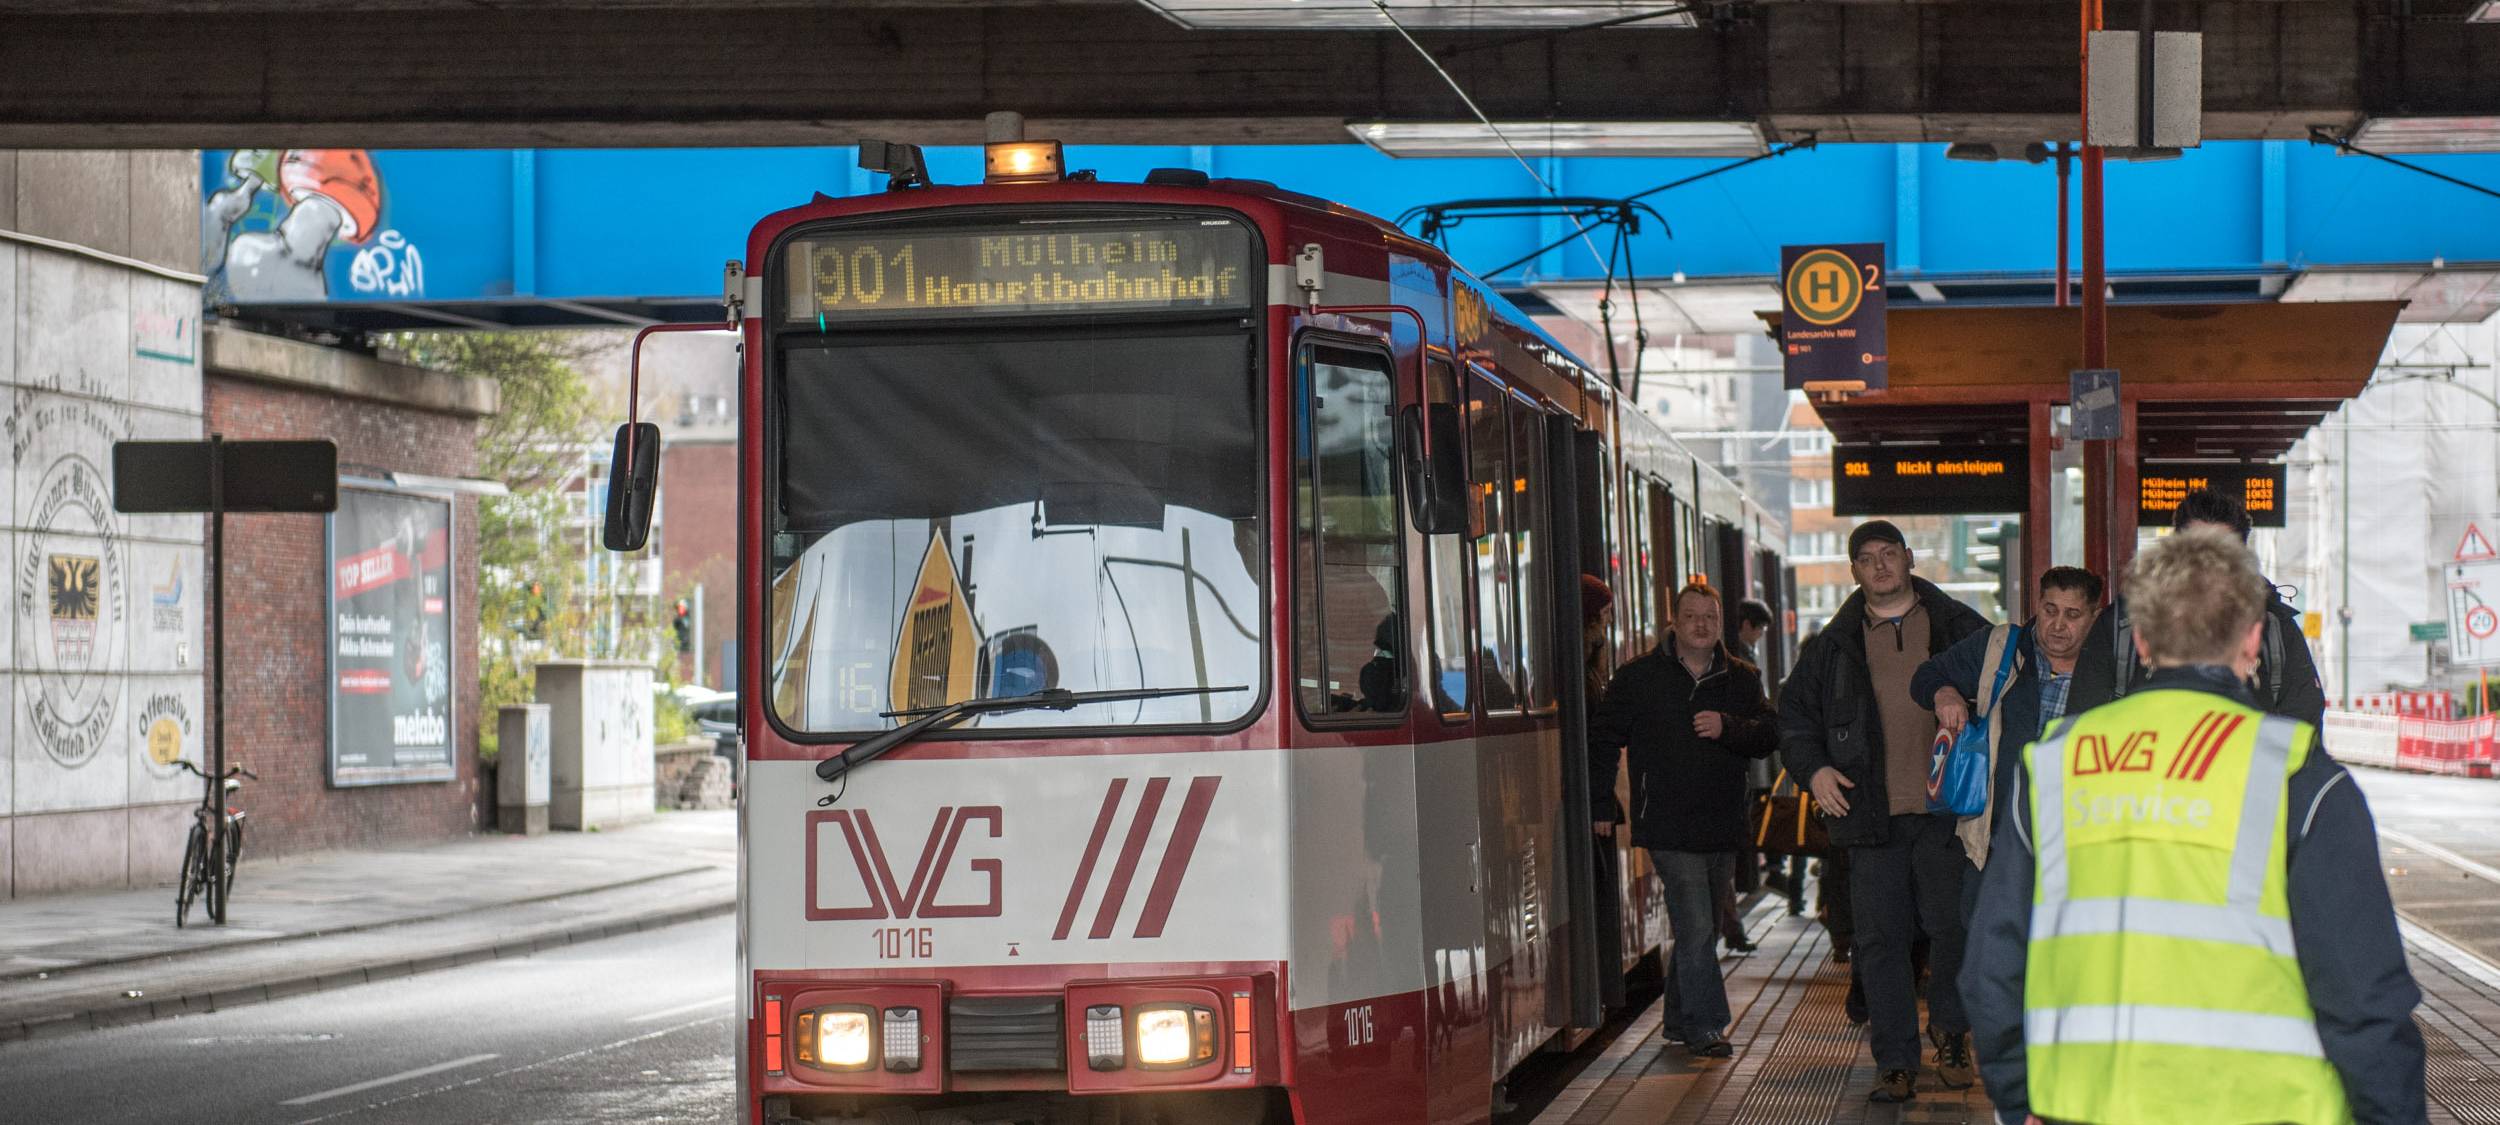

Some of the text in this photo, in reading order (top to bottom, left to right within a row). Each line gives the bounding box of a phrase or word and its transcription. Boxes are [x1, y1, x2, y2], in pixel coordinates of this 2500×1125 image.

[813, 232, 1177, 304] 901 Mülheim
[1865, 264, 1880, 291] 2
[925, 266, 1237, 305] Hauptbahnhof
[1810, 271, 1838, 303] H
[1787, 328, 1857, 339] Landesarchiv NRW
[1845, 459, 2005, 476] 901 Nicht einsteigen
[2142, 478, 2186, 488] Mülheim
[2245, 478, 2273, 488] 10:18
[2142, 488, 2273, 499] Mülheim 10:33
[2142, 499, 2178, 510] Mülhei
[339, 563, 360, 592] TOP
[339, 613, 356, 633] Dein
[2473, 614, 2491, 628] 20
[139, 693, 191, 736] Offensive
[393, 707, 444, 746] metabo
[2073, 731, 2158, 776] DVG
[2071, 784, 2213, 829] Service
[805, 806, 1002, 921] DVG
[872, 928, 932, 959] 1016
[1345, 1005, 1374, 1046] 1016
